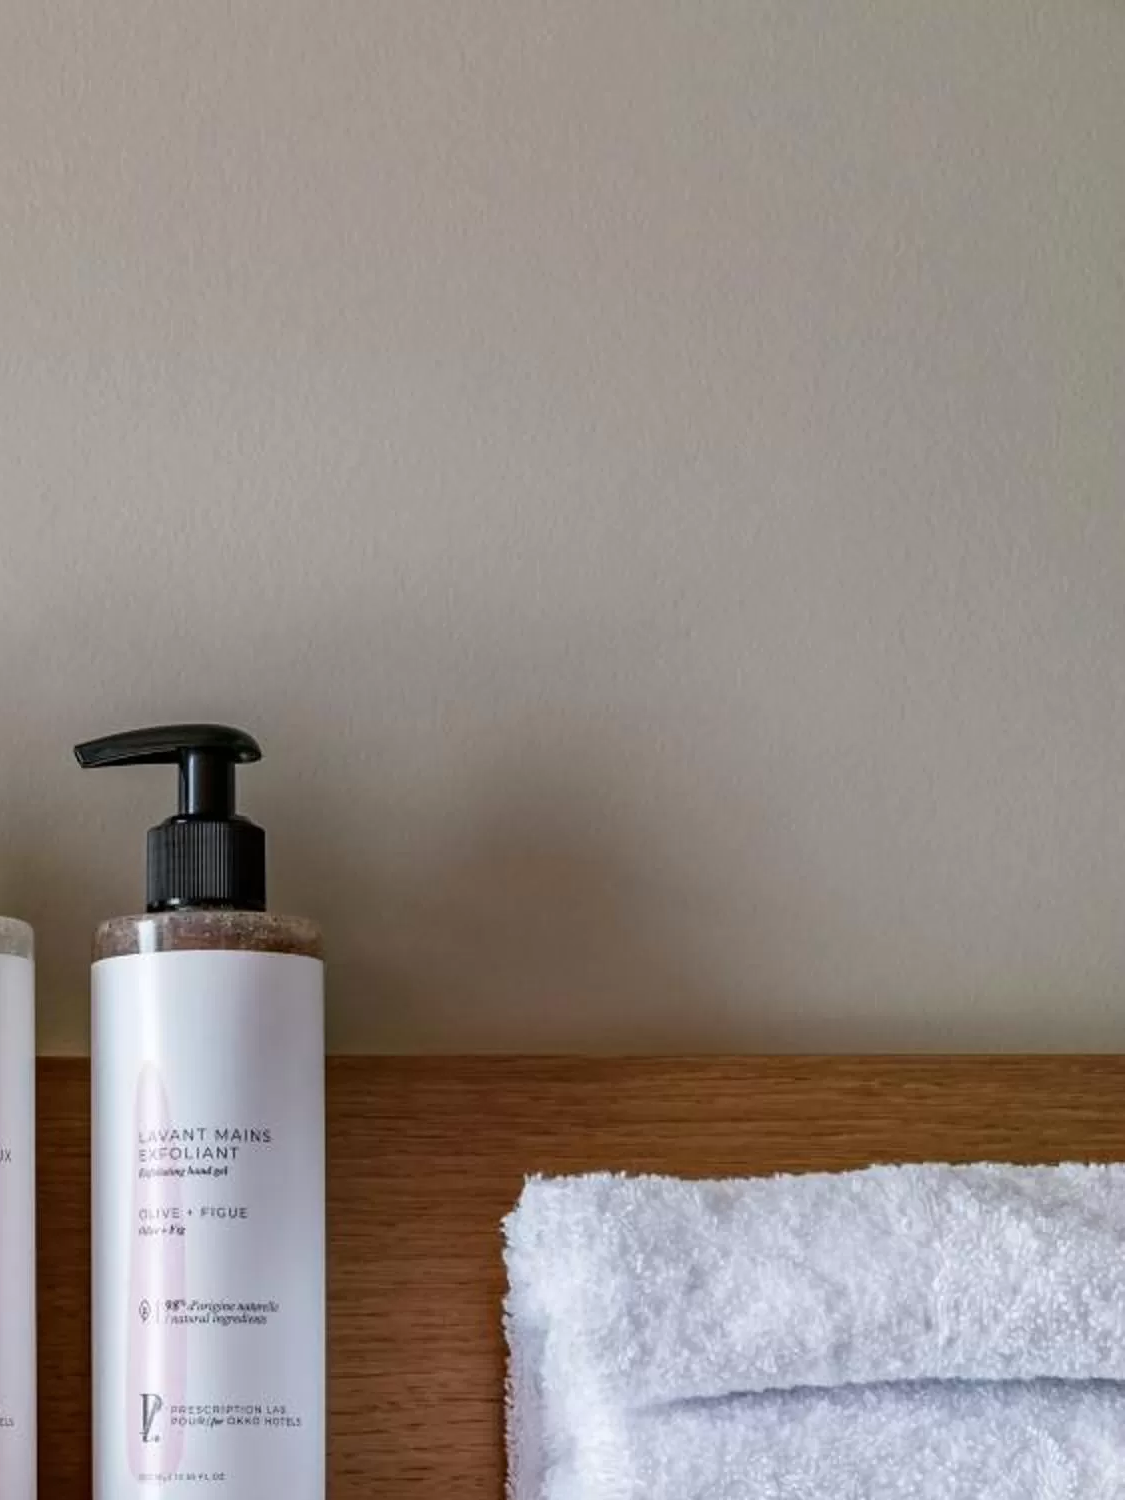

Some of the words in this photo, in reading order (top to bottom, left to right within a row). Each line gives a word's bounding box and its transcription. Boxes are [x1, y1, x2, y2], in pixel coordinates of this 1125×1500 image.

[138, 1128, 207, 1144] LAVANT
[215, 1128, 272, 1143] MAINS
[138, 1147, 239, 1162] EXFOLIANT
[187, 1166, 212, 1176] hand
[213, 1166, 228, 1177] gel
[138, 1207, 180, 1220] OLIVE
[201, 1207, 248, 1219] FIGUE
[170, 1404, 262, 1415] PRESCRIPTION
[265, 1405, 286, 1415] LAB
[226, 1416, 260, 1426] OKKO
[264, 1416, 302, 1427] HOTELS
